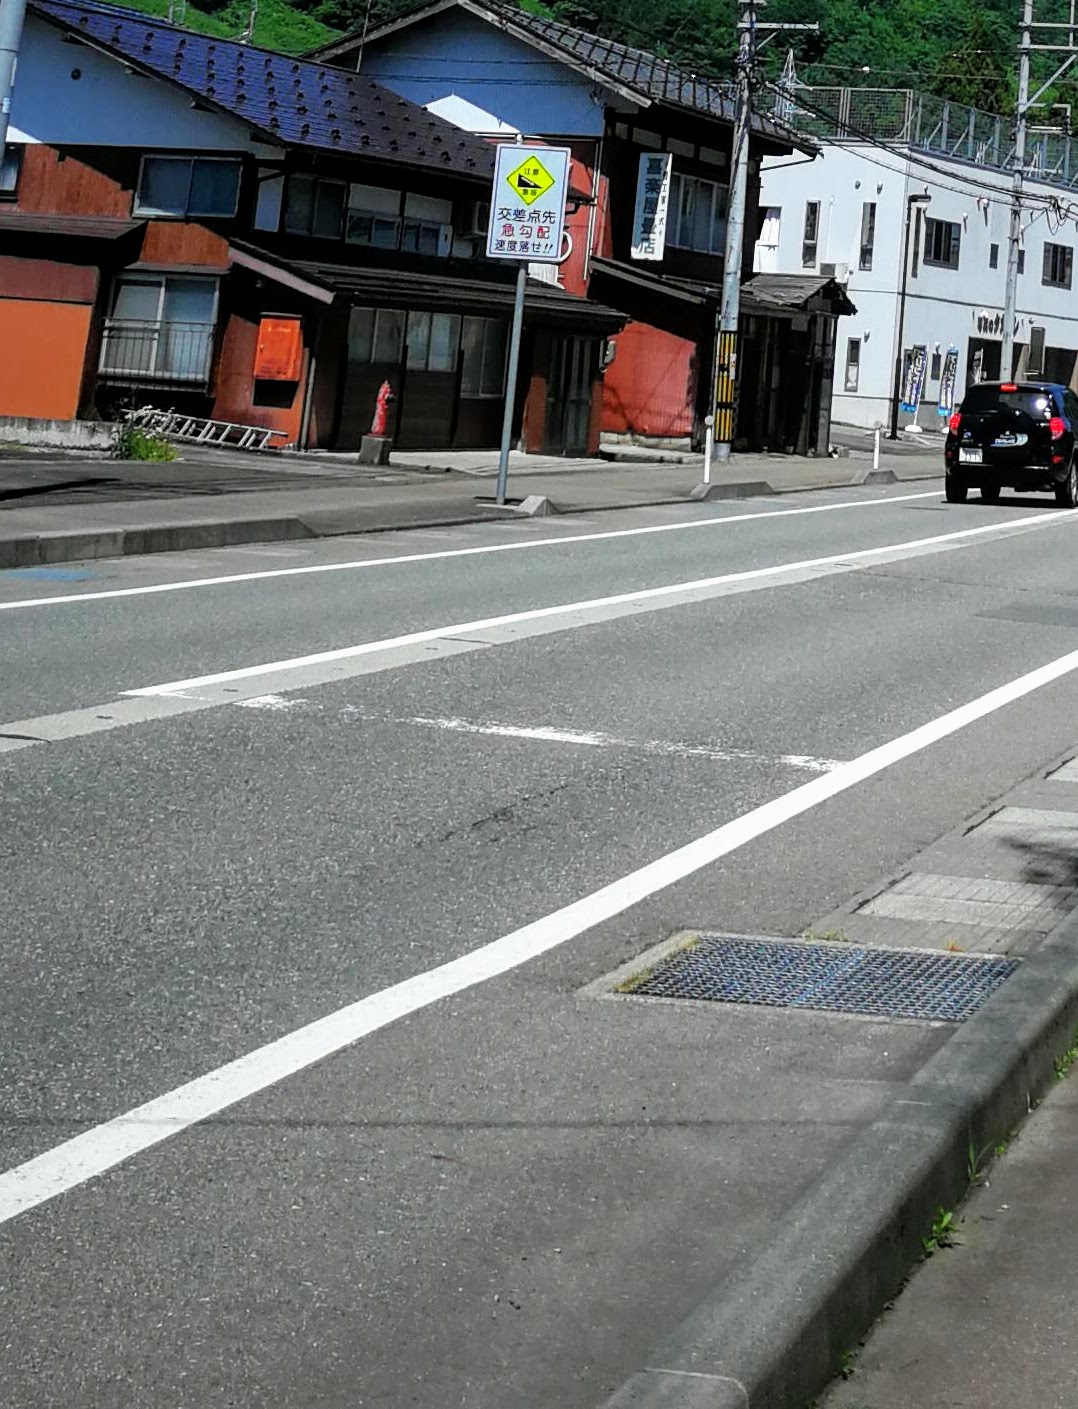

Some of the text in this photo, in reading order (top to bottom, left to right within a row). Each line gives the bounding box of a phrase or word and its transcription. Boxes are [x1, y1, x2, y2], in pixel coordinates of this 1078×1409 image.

[497, 207, 556, 224] 交差点先
[501, 223, 550, 239] 急勾配
